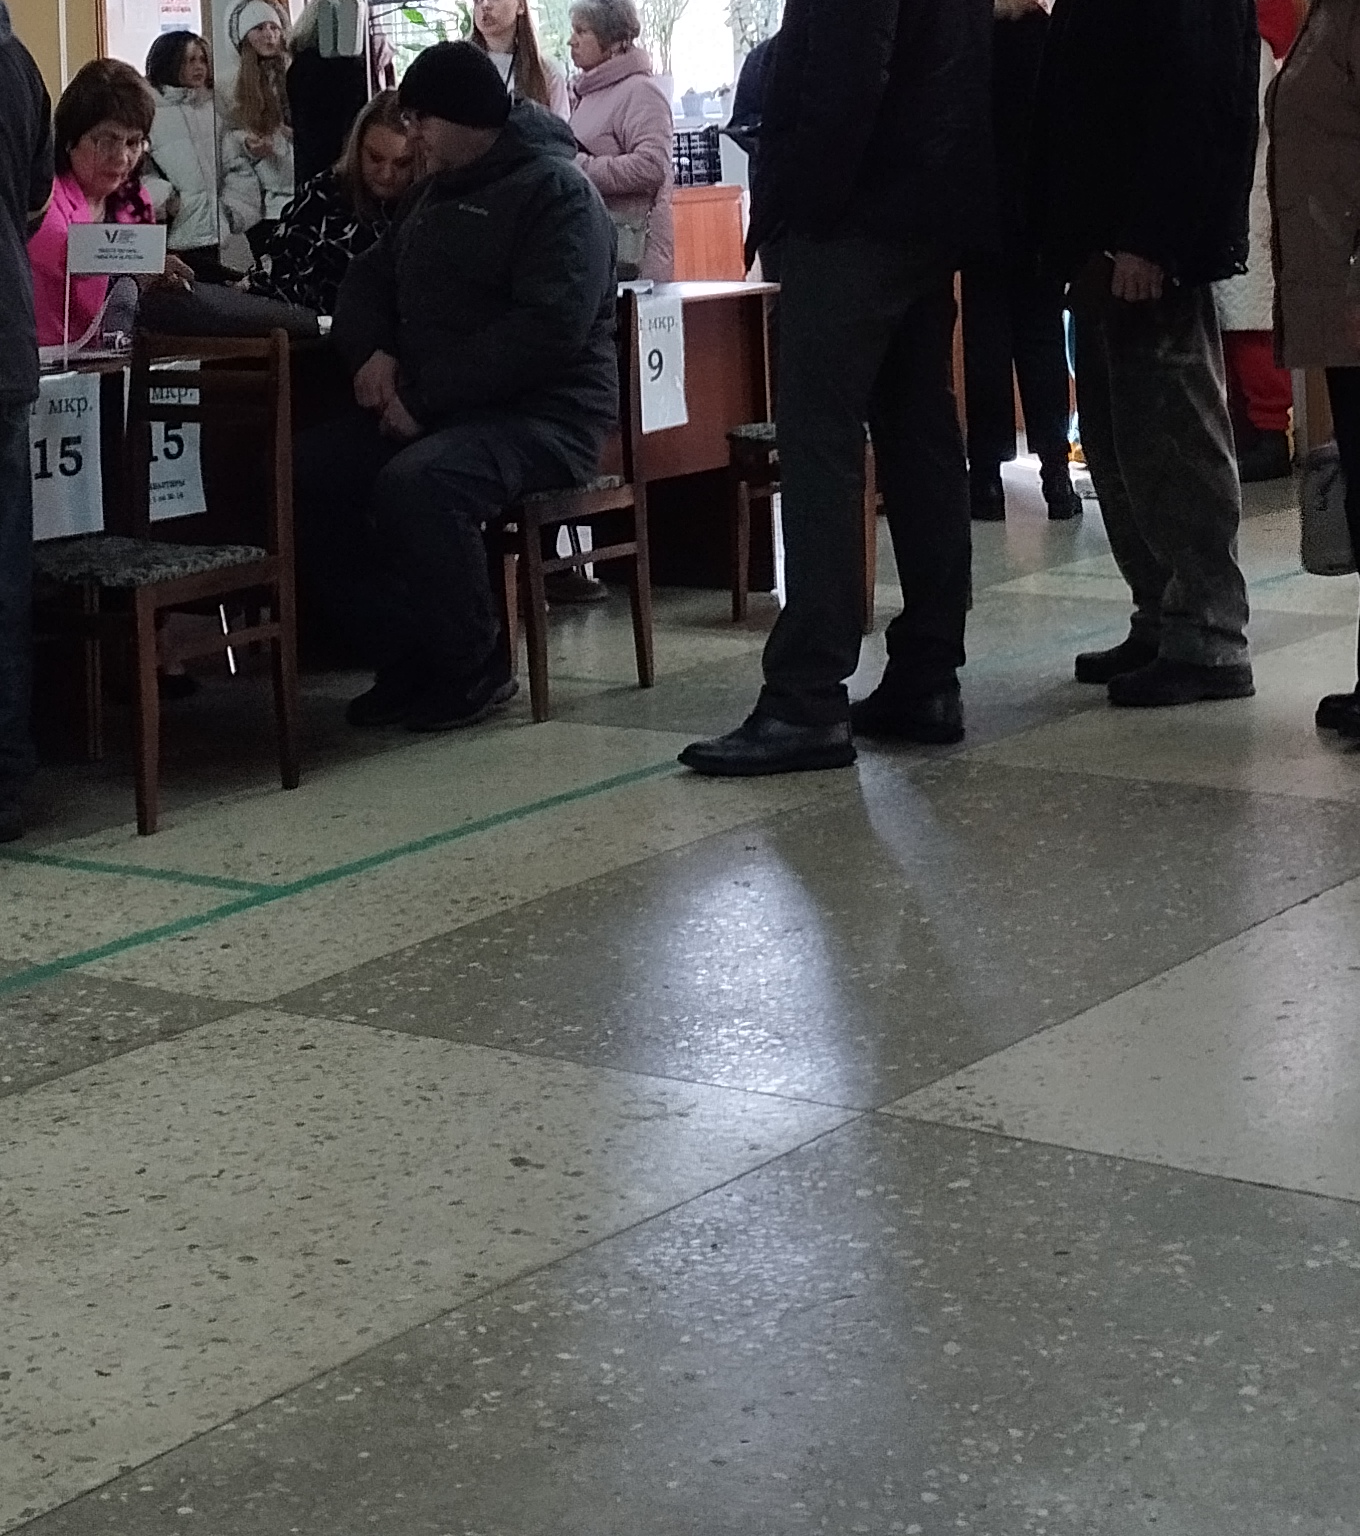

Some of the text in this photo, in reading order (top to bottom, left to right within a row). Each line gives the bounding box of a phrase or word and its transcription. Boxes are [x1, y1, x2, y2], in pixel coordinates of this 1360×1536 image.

[648, 348, 664, 382] 9
[48, 397, 93, 418] мкр.
[34, 435, 83, 480] 15
[150, 423, 184, 462] 5
